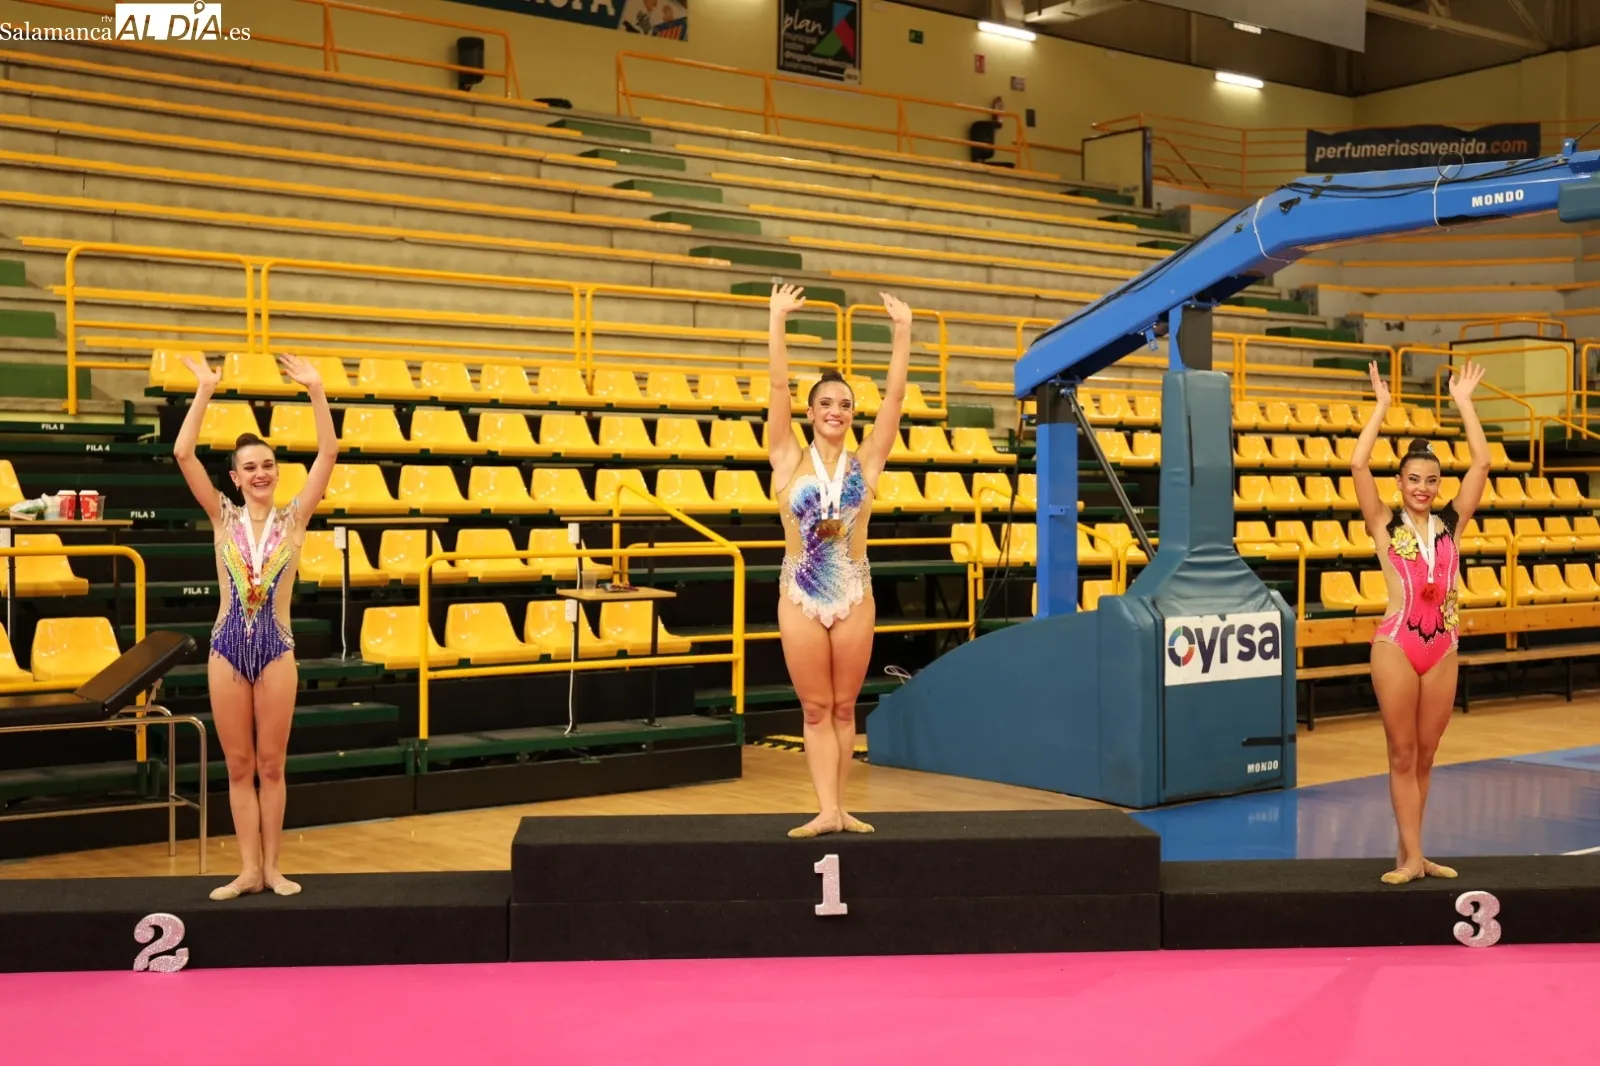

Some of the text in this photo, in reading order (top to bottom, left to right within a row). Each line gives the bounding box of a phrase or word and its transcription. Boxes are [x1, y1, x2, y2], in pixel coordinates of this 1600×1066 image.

[782, 8, 827, 36] plan
[1314, 137, 1528, 163] perfumeriasavenida.com
[1471, 188, 1525, 209] MONDO
[85, 444, 111, 452] FILA 4
[130, 511, 156, 519] FILA 3
[183, 587, 210, 595] FILA 2
[1247, 760, 1279, 774] MONDO
[813, 853, 849, 917] 1
[1453, 890, 1502, 948] 3
[132, 912, 190, 973] 2
